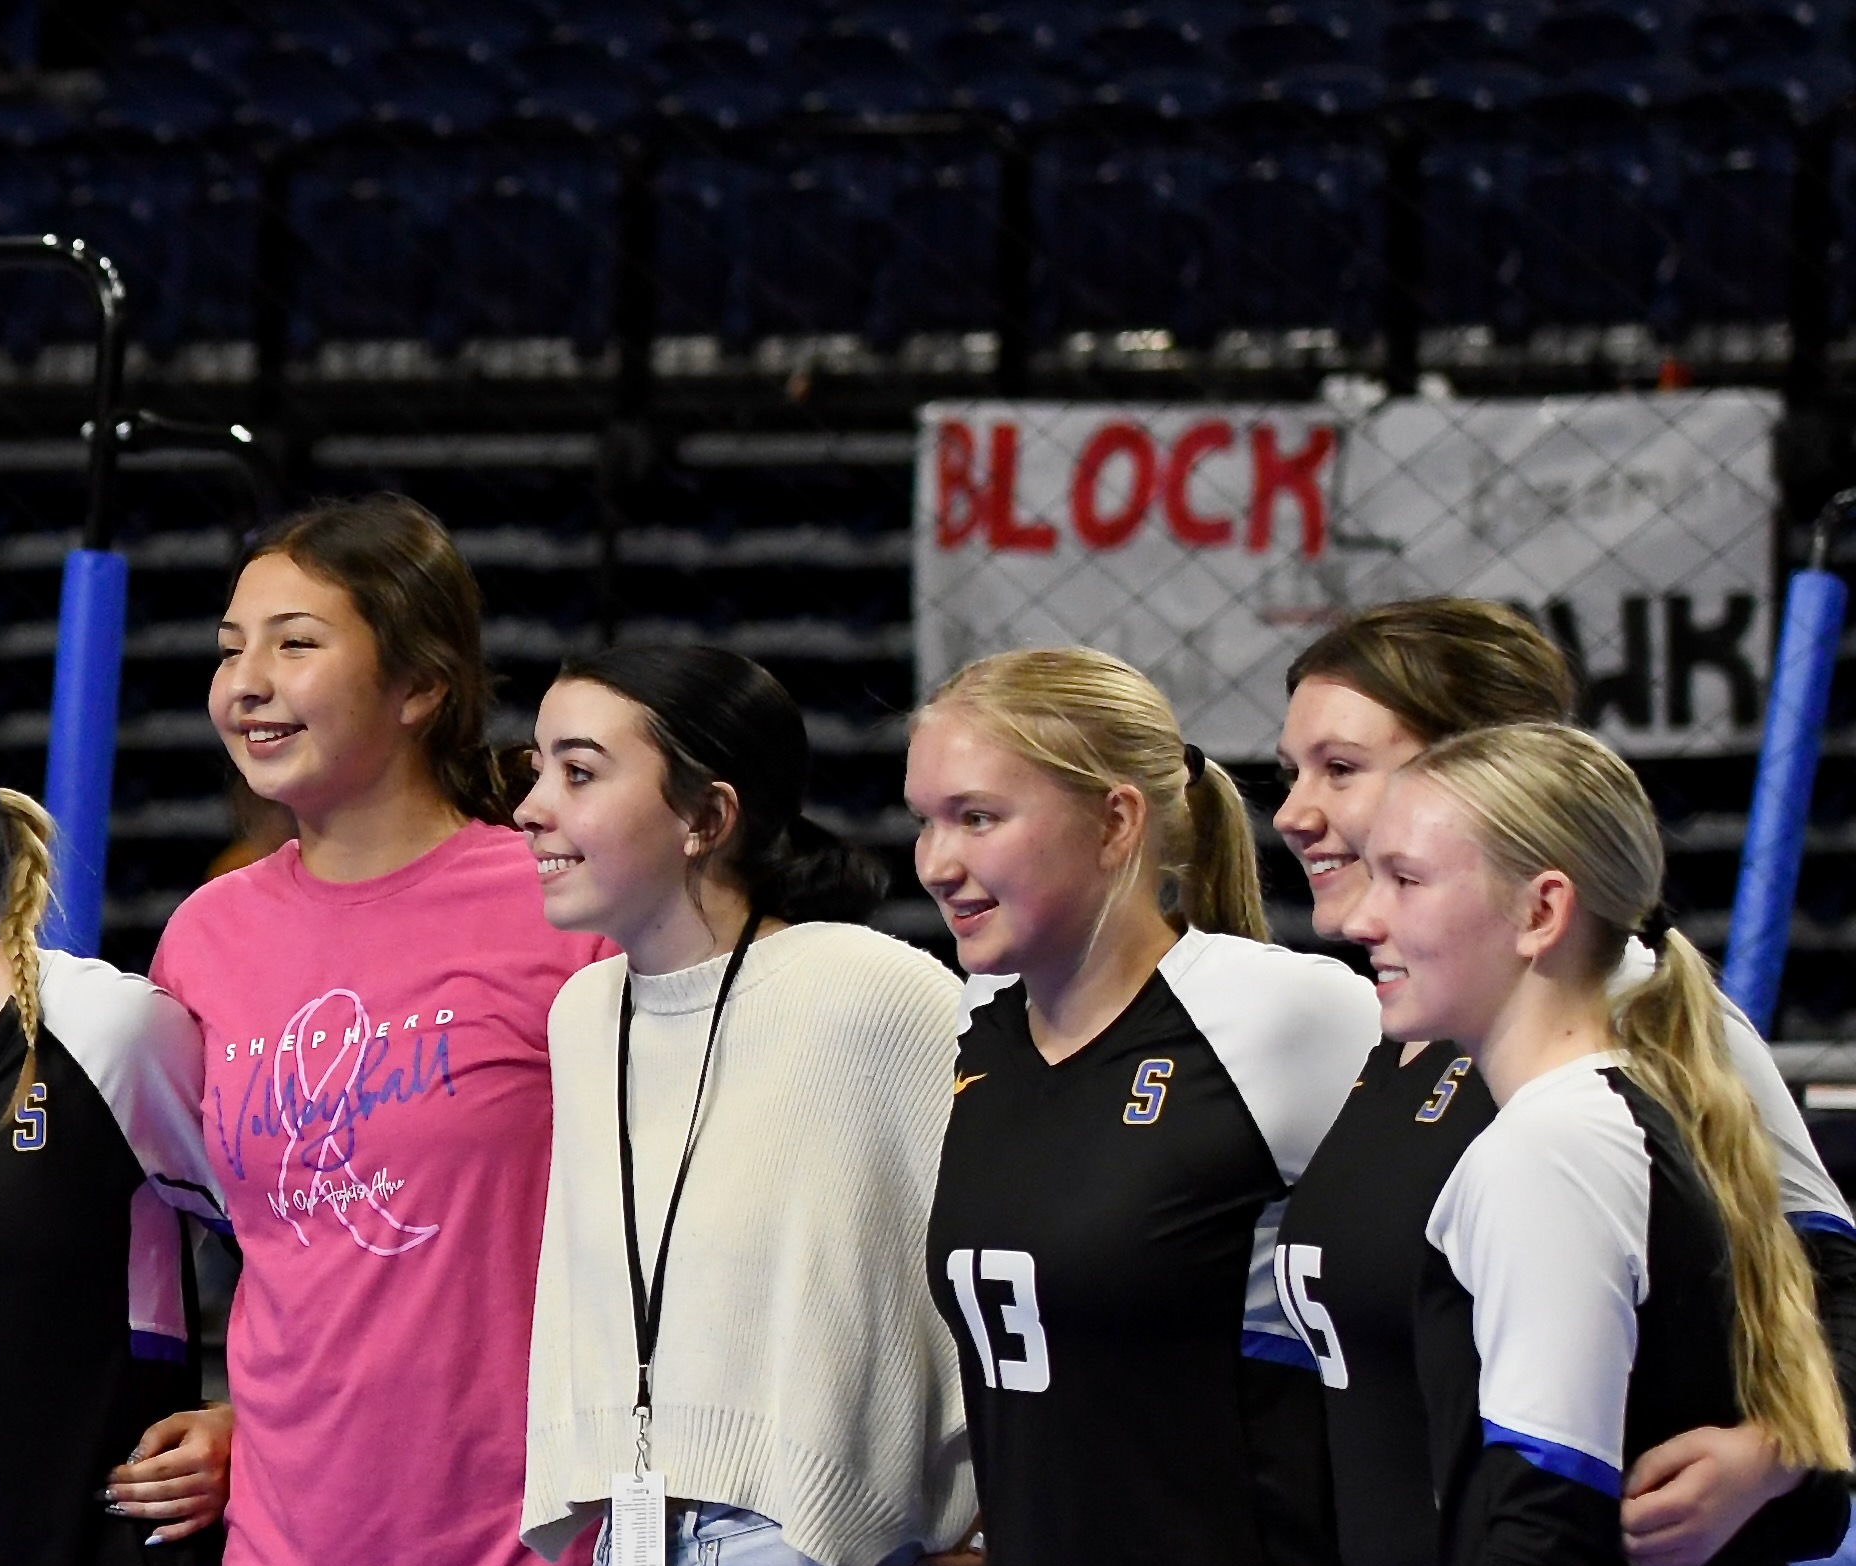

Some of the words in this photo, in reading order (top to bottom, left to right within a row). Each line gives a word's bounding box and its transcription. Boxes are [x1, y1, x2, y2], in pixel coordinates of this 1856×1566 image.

[935, 418, 1338, 558] BLOCK
[225, 1009, 453, 1062] SHEPHERD
[11, 1081, 48, 1153] S
[1122, 1057, 1175, 1126] S
[1413, 1056, 1472, 1124] S
[946, 1249, 1051, 1394] 13
[1273, 1243, 1349, 1390] 15
